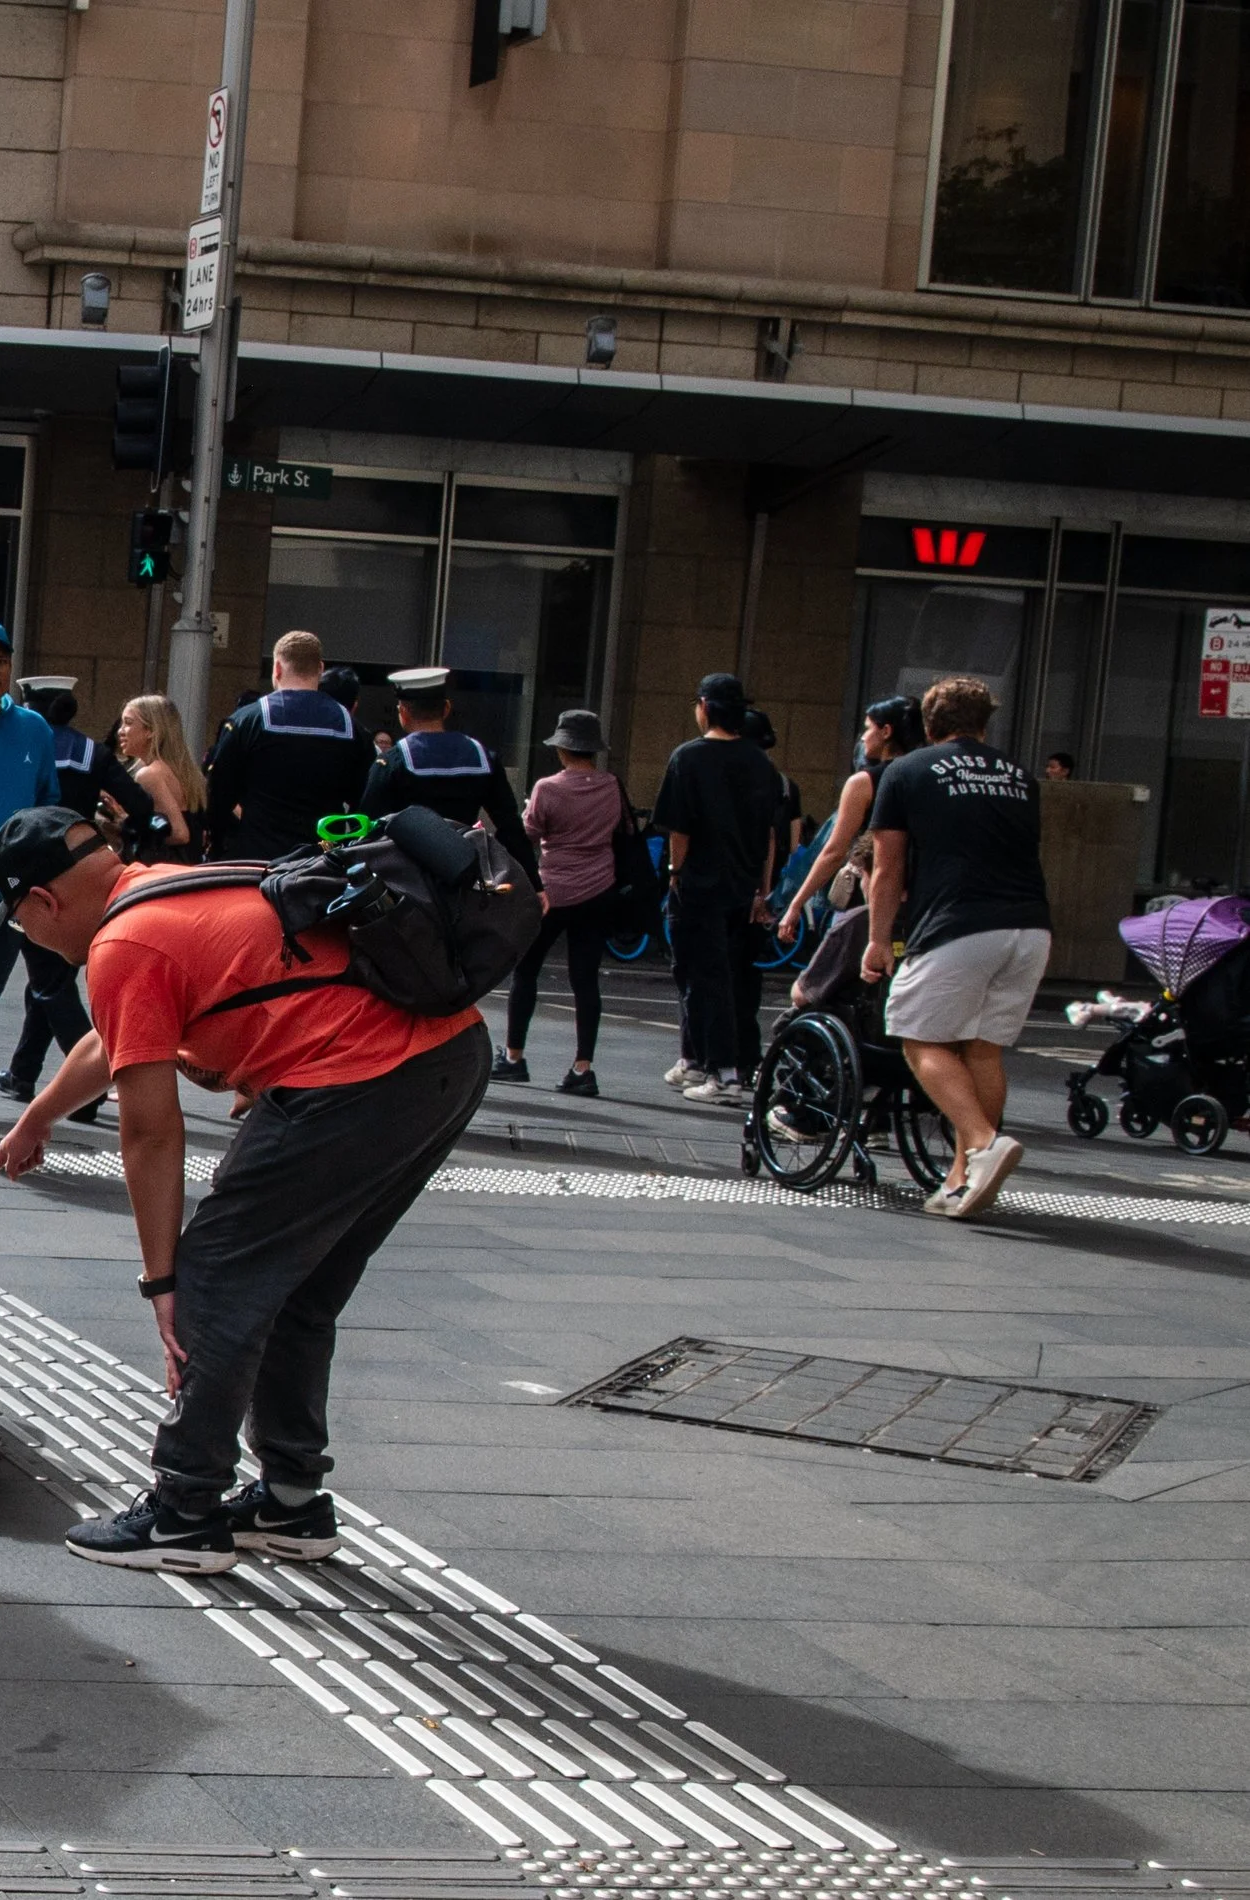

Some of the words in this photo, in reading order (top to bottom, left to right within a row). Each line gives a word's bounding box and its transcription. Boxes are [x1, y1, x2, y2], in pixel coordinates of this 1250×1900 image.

[209, 151, 220, 172] NO
[206, 173, 219, 190] LEFT
[204, 192, 218, 207] TURN
[190, 263, 214, 288] LANE
[186, 296, 213, 318] 24hrs
[253, 465, 290, 486] Park
[293, 469, 311, 488] St
[1210, 662, 1223, 672] NO
[930, 755, 987, 776] GLASS
[995, 758, 1024, 780] AVE
[956, 767, 1012, 784] Newport
[947, 782, 1030, 802] AUSTRALIA
